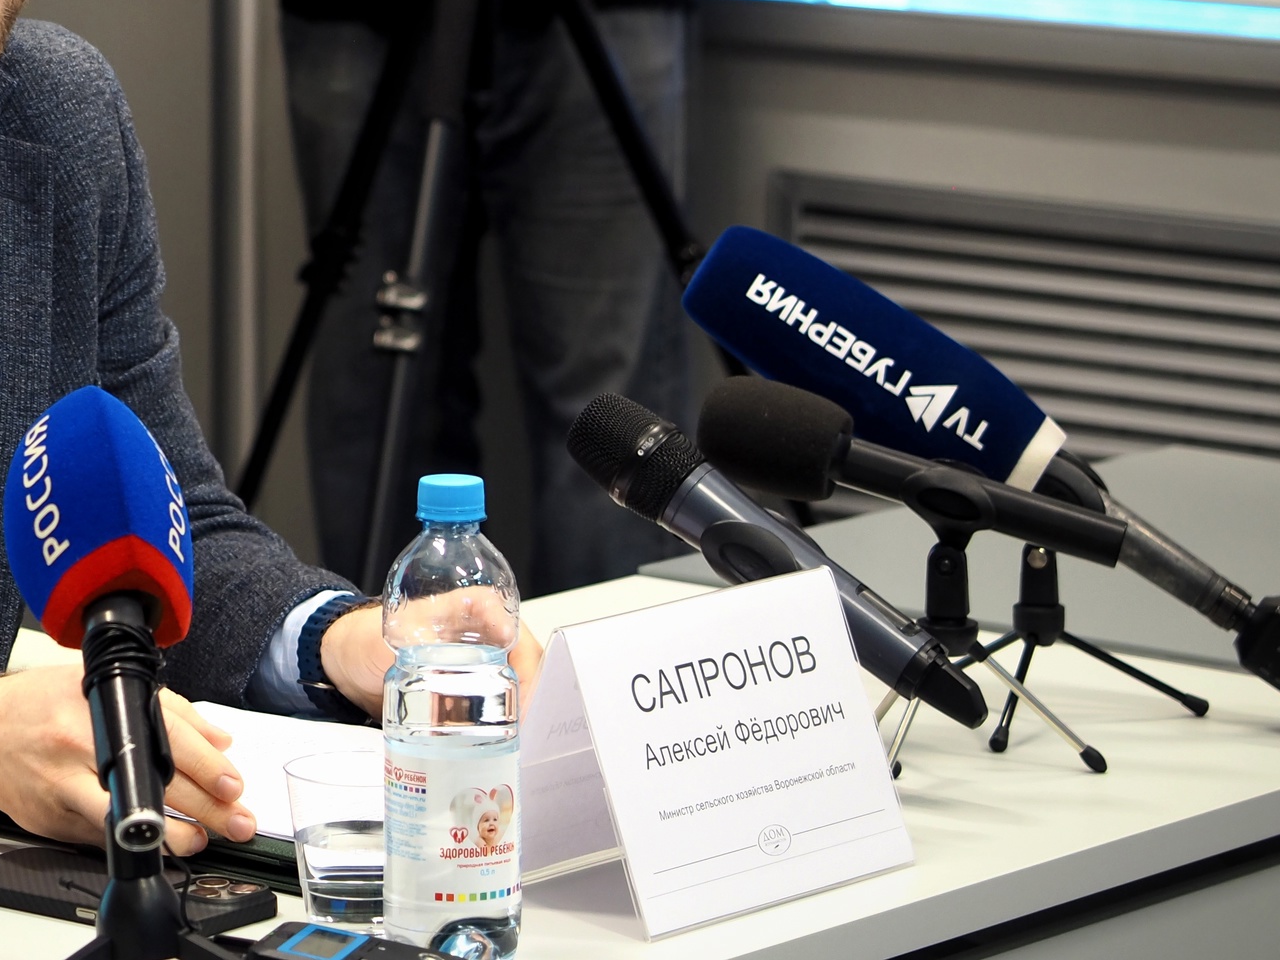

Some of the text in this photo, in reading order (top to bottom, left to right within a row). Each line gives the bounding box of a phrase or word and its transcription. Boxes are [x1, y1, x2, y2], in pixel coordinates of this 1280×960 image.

[745, 273, 989, 451] TV ГУБЕРНИЯ
[23, 415, 70, 566] РОССИЯ
[146, 430, 187, 564] РОСС
[631, 635, 817, 713] САПРОНОВ
[645, 701, 845, 770] Алексей Фёдорович
[658, 761, 856, 821] Министр сельского хозяйства Воронежской области
[439, 844, 488, 859] ЗДОРОВЫЙ
